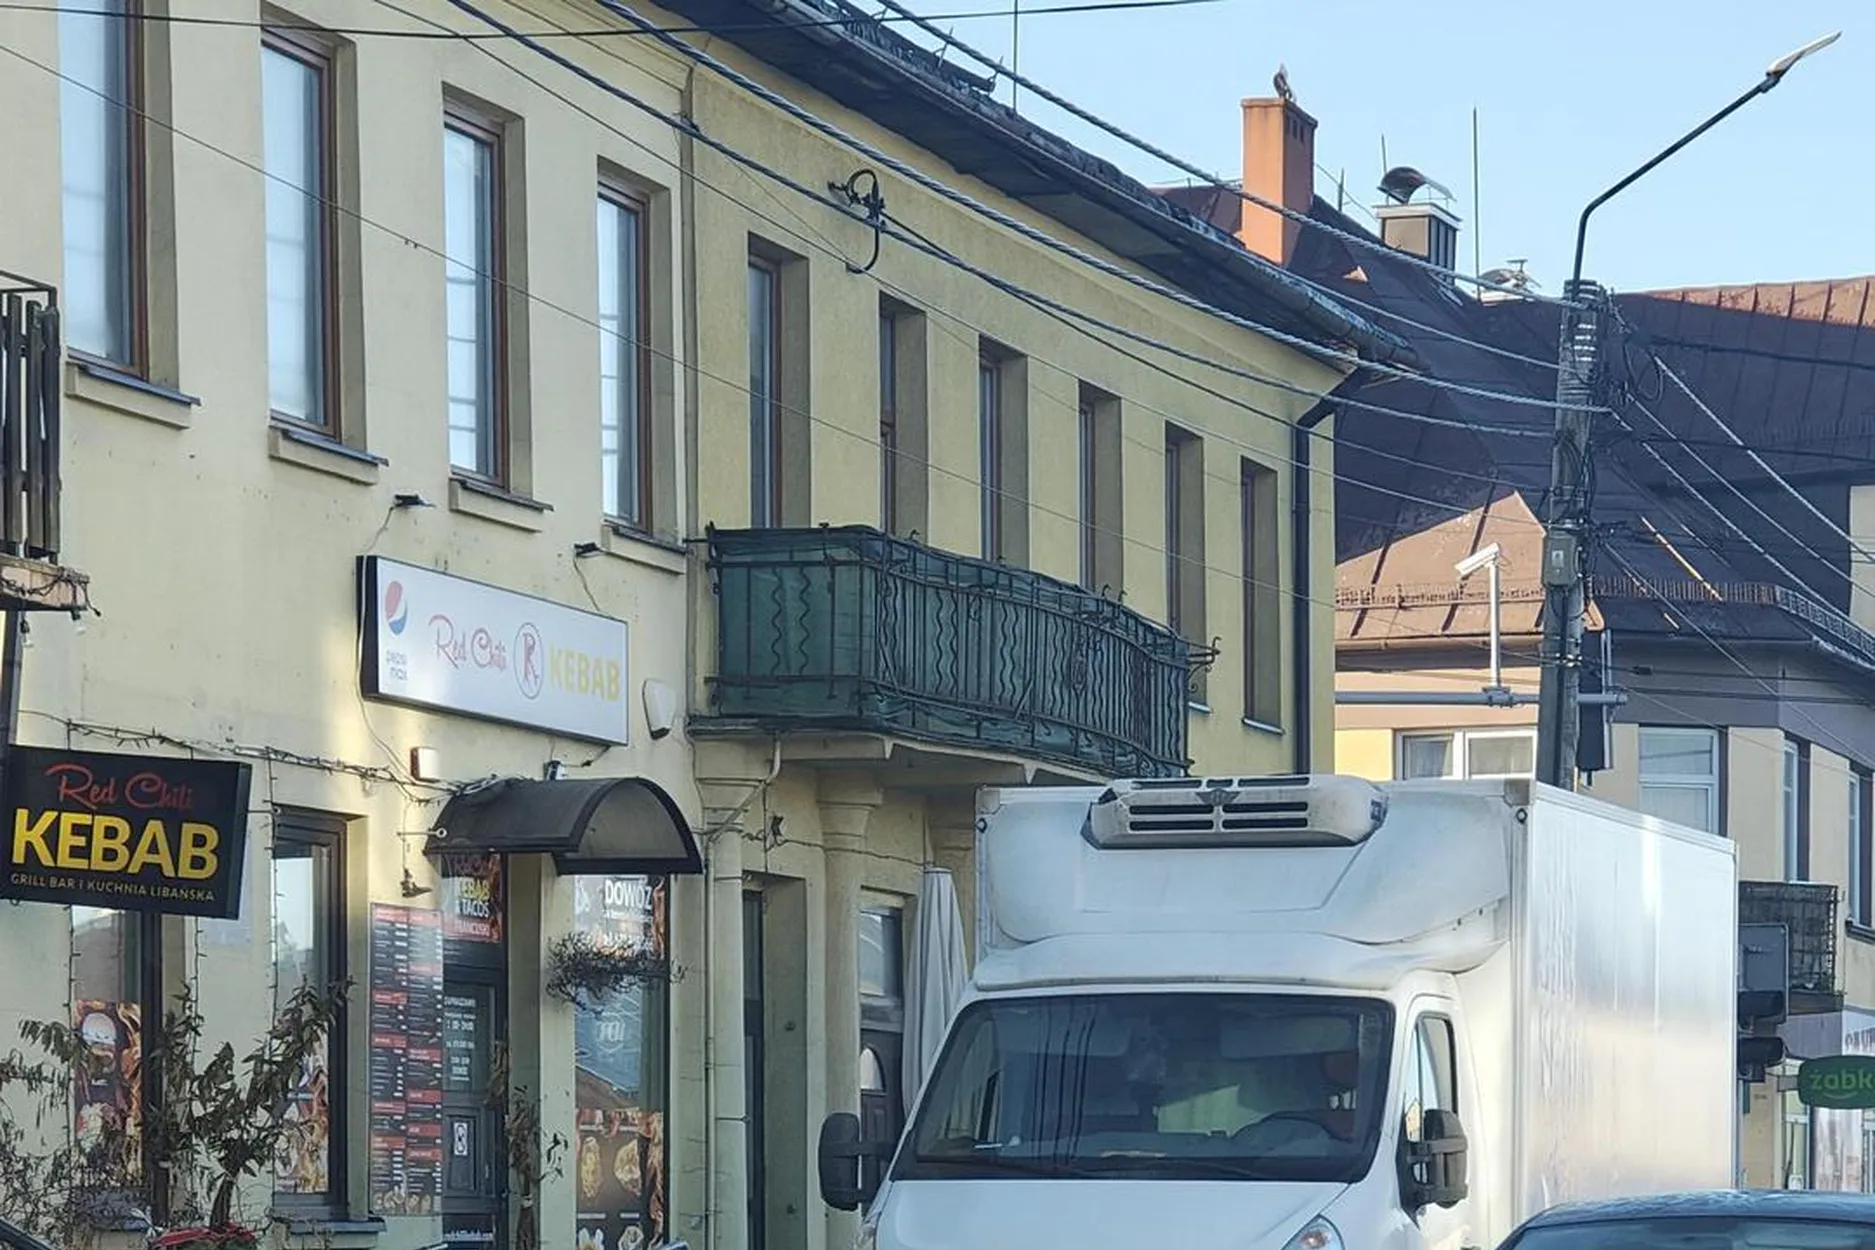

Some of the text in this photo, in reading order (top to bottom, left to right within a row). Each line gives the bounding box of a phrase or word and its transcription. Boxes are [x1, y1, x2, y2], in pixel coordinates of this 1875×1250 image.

[428, 614, 467, 669] Red
[550, 646, 621, 701] KEBAB
[45, 763, 194, 809] Red Chili
[12, 808, 220, 880] KEBAB
[11, 872, 47, 887] GRILL
[49, 876, 76, 890] BAR
[87, 879, 147, 896] KUCHNIA
[1809, 1068, 1875, 1091] żabk
